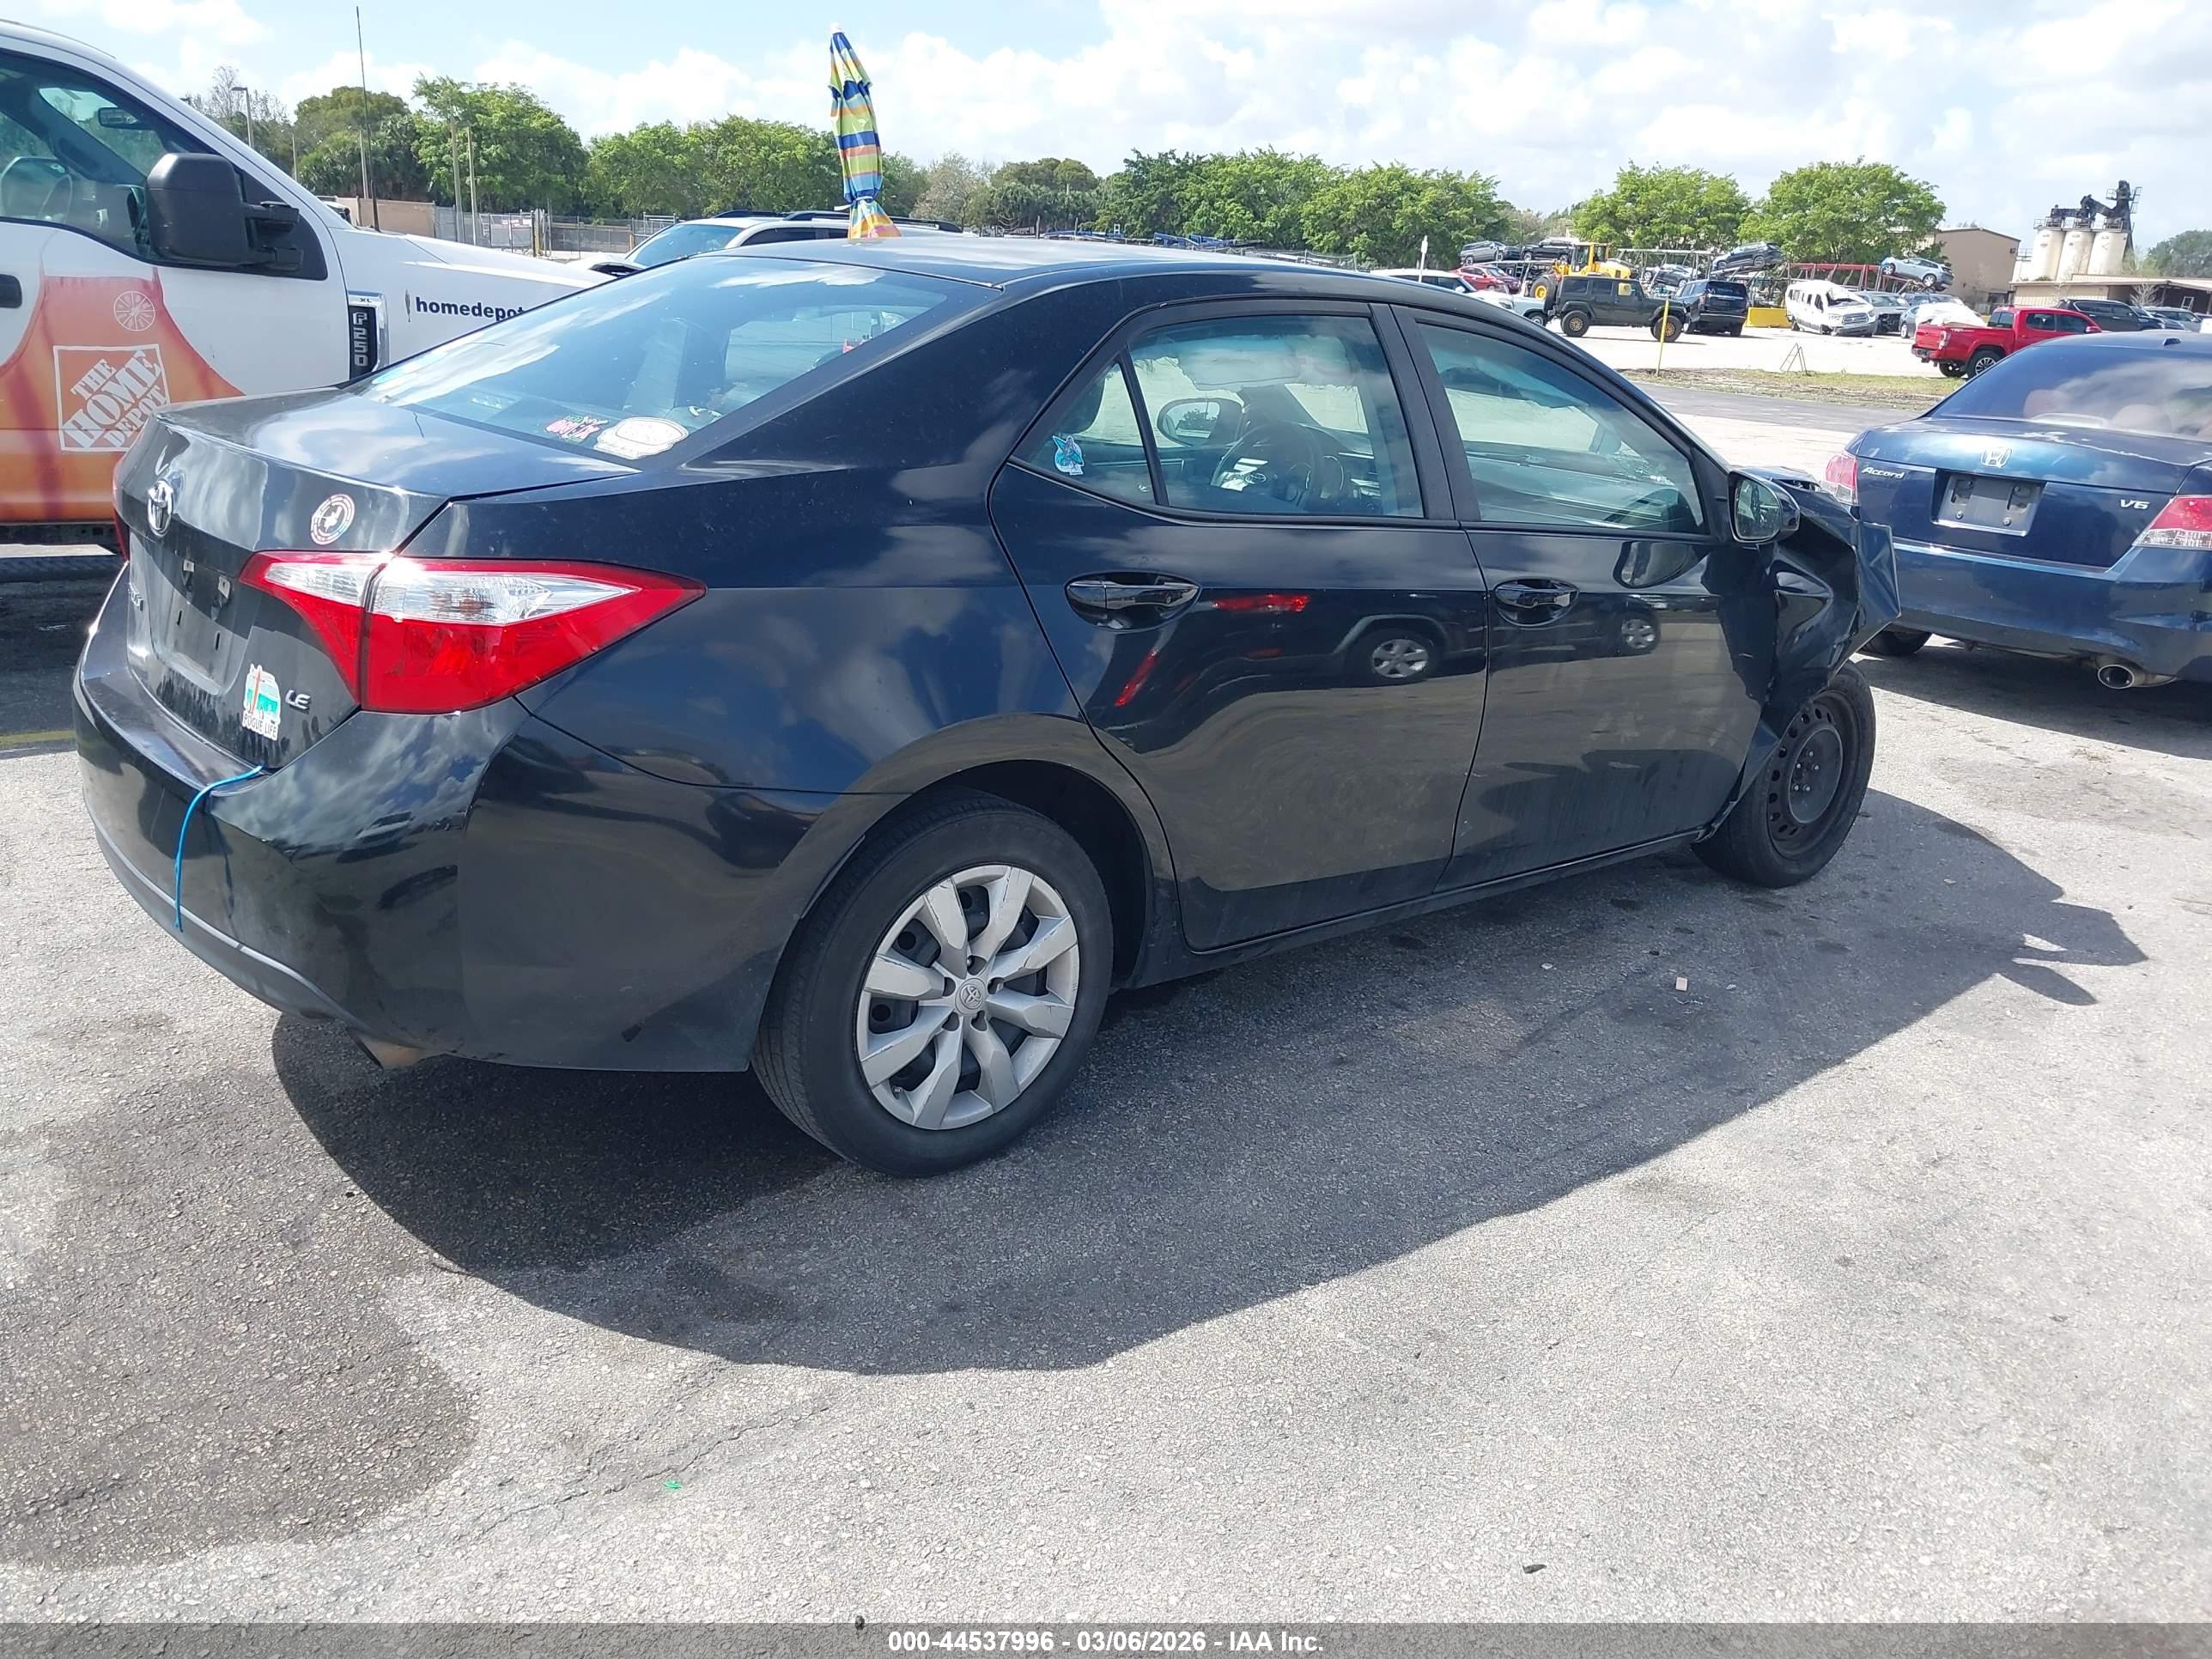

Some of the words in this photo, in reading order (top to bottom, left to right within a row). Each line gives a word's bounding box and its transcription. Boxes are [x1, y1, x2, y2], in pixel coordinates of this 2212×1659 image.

[70, 358, 117, 400] THE
[62, 349, 162, 448] HOME
[104, 385, 167, 448] DEPOT
[1861, 466, 1905, 479] Accord
[2119, 498, 2151, 510] V6
[285, 689, 311, 710] LE
[244, 713, 264, 732] POGUE
[264, 721, 277, 738] LIFE
